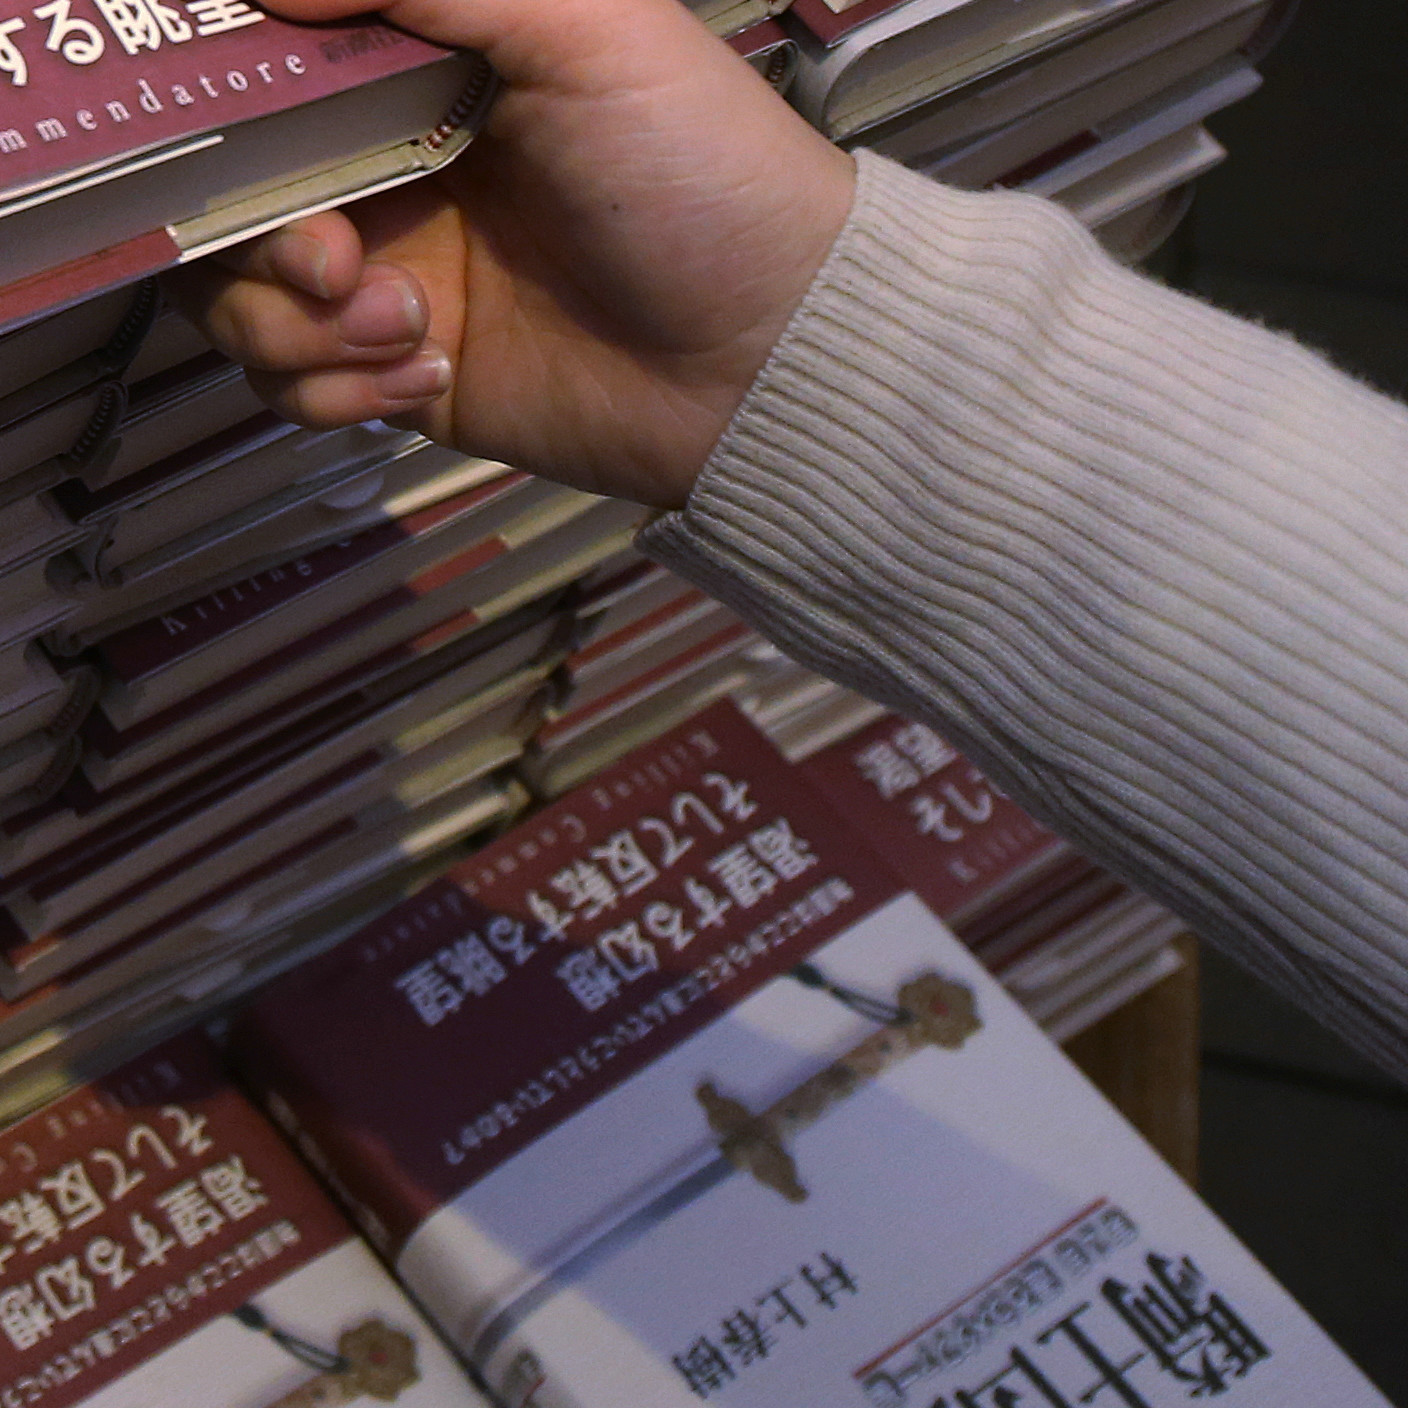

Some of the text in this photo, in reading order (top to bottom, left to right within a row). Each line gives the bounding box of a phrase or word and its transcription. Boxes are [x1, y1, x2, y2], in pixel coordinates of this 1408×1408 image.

[910, 768, 996, 842] そし
[394, 771, 757, 1027] そして反転する眺望
[553, 816, 819, 1012] 渇望する幻想
[670, 1253, 859, 1400] 村上春樹
